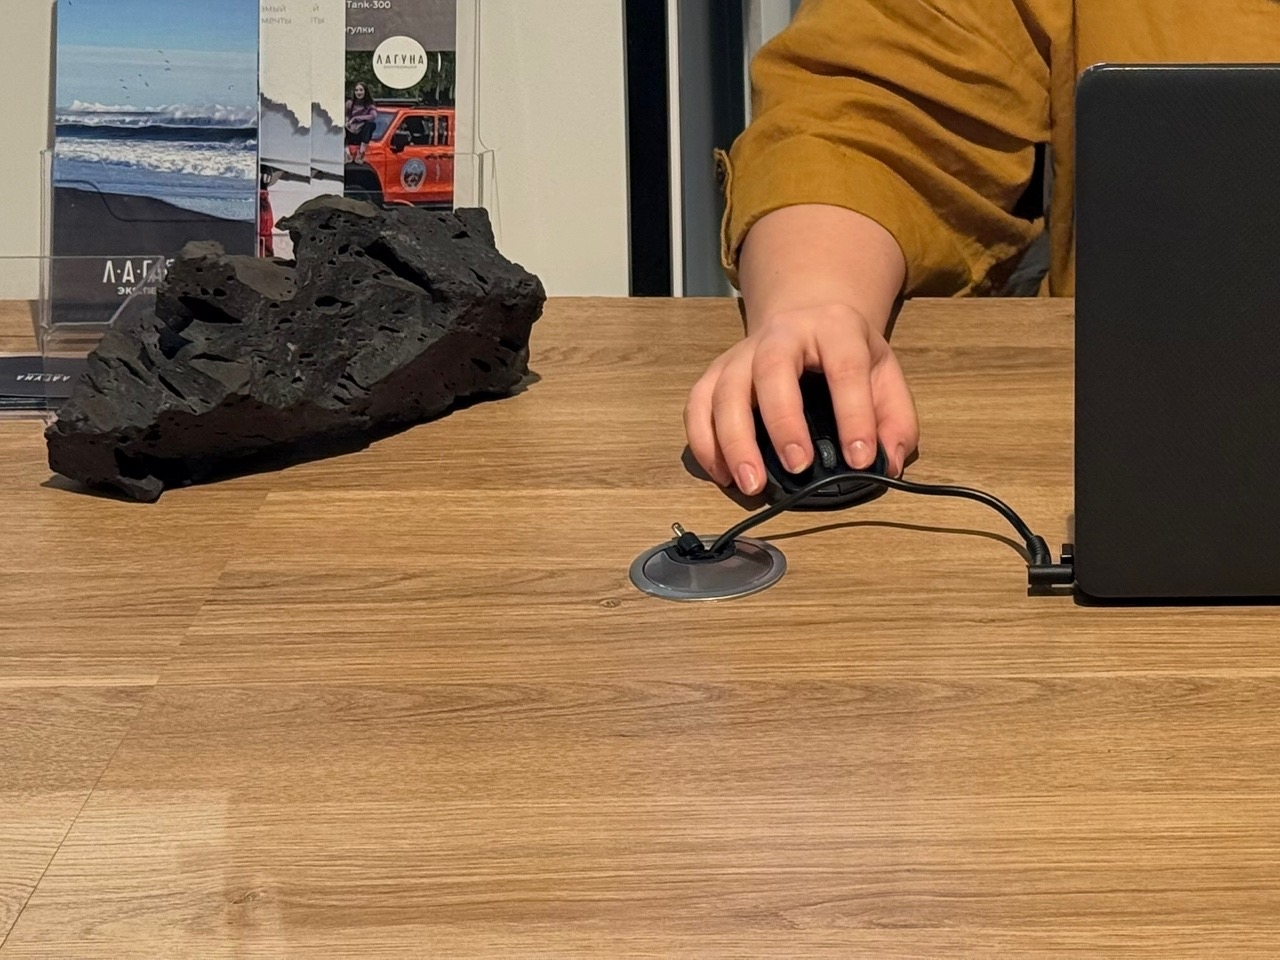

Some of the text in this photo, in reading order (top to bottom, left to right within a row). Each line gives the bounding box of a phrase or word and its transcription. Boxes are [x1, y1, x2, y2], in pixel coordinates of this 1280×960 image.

[346, 0, 391, 9] Tank-300
[345, 26, 375, 35] гулки
[376, 54, 424, 65] ЛАГУНА
